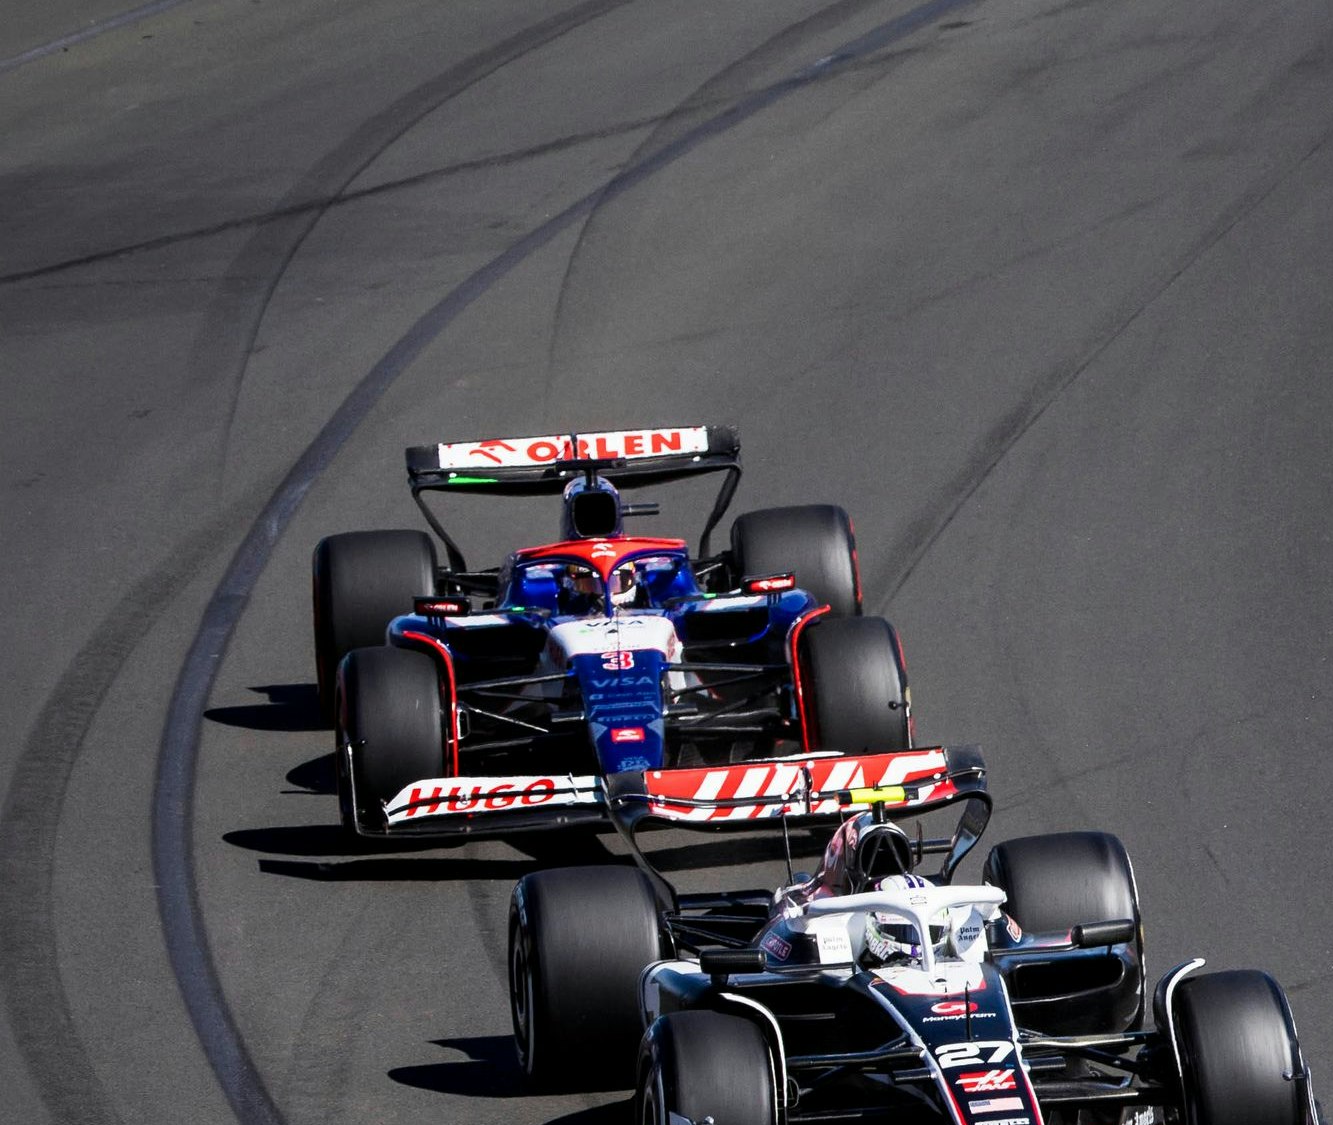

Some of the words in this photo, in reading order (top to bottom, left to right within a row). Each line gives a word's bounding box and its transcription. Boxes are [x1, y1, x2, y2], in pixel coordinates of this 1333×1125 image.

[526, 432, 681, 462] ORLEN
[600, 651, 635, 671] 3
[591, 676, 654, 688] VISA
[405, 778, 556, 818] HUGO
[935, 1040, 1016, 1070] 27
